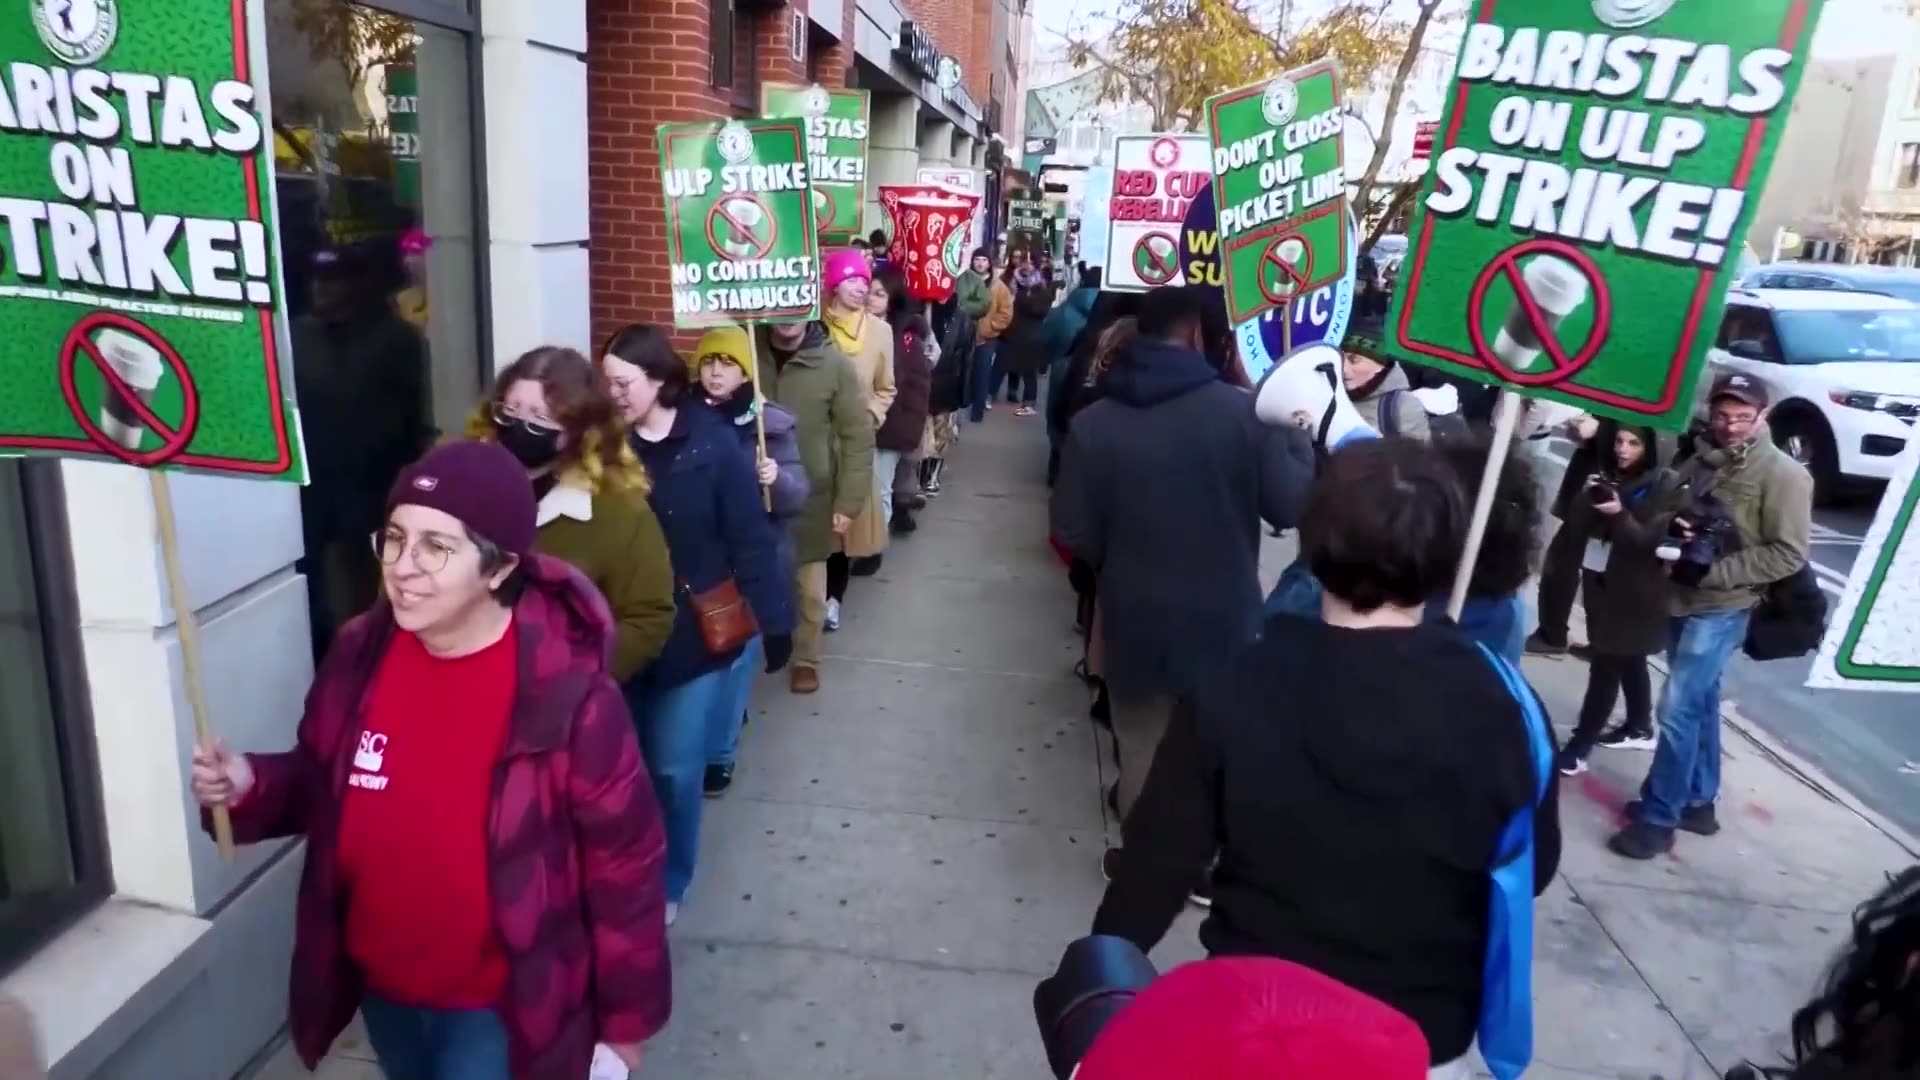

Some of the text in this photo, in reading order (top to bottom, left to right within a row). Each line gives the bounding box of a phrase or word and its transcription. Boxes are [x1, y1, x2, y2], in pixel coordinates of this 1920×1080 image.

[1458, 24, 1792, 113] BARISTAS
[1214, 108, 1343, 176] DON'T CROSS
[1489, 96, 1705, 169] ON ULP
[51, 141, 136, 208] ON
[665, 162, 809, 197] ULP STRIKE
[1114, 170, 1157, 198] RED
[1219, 184, 1297, 241] PICKET
[1301, 168, 1346, 208] LINE
[1258, 154, 1303, 190] OUR
[1426, 147, 1747, 264] STRIKE!
[672, 255, 816, 285] NO CONTRACT,
[675, 285, 818, 314] NO STARBUCKS!
